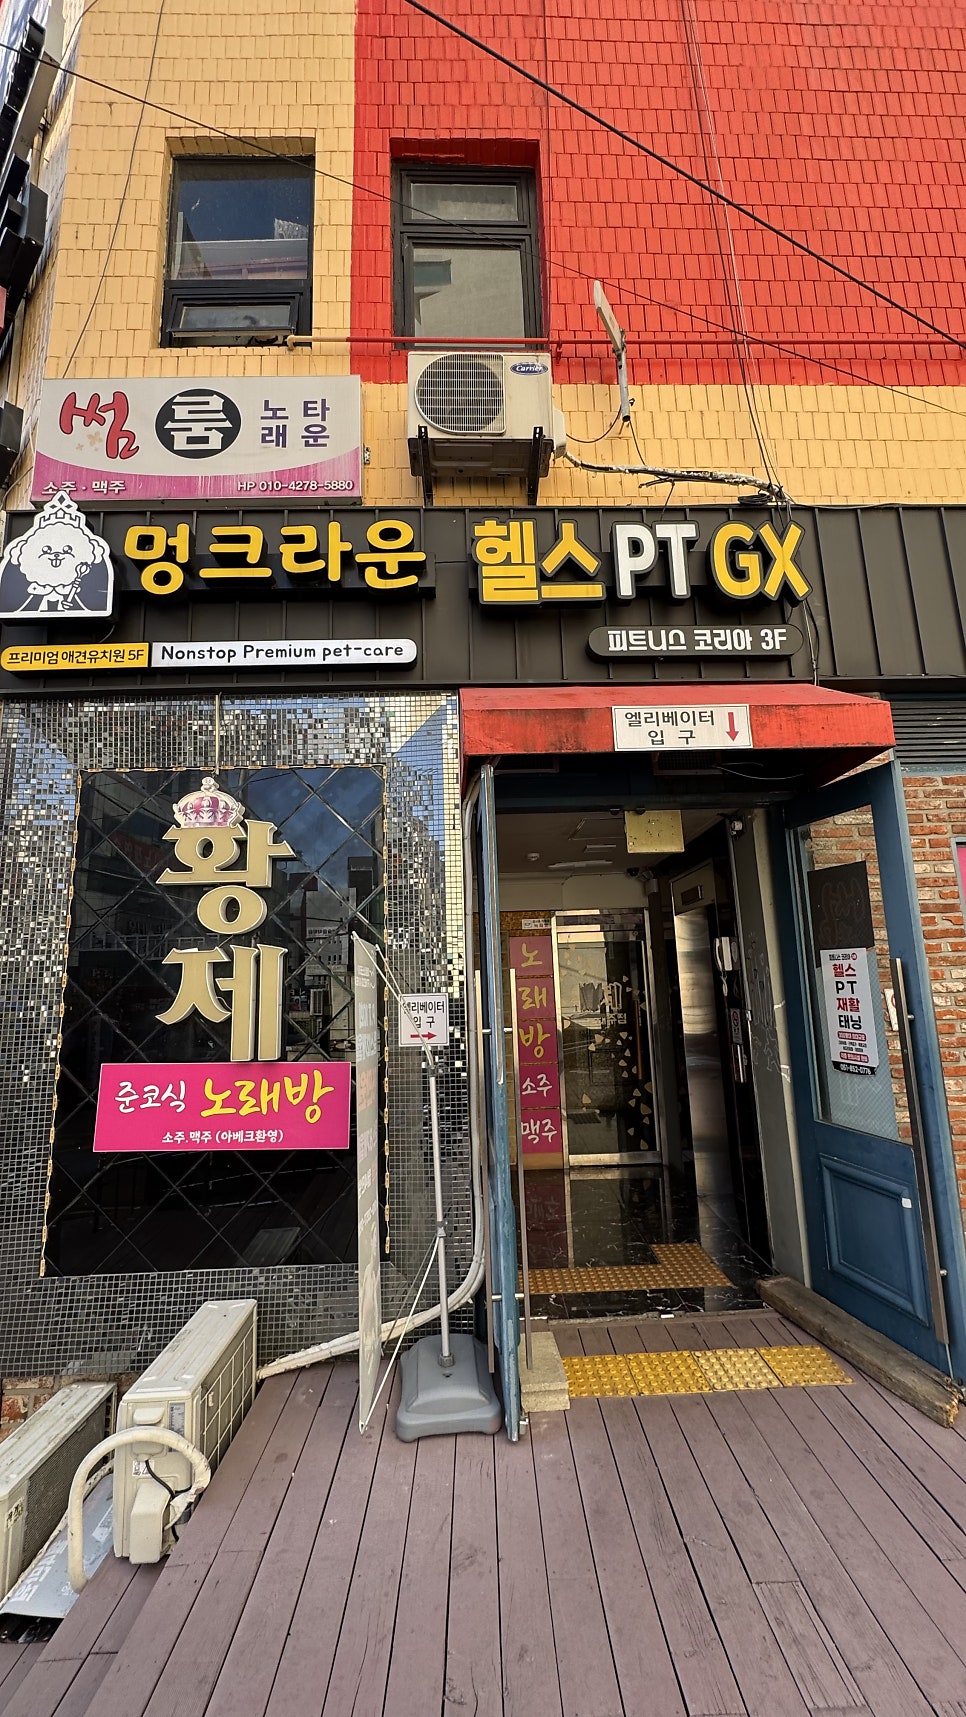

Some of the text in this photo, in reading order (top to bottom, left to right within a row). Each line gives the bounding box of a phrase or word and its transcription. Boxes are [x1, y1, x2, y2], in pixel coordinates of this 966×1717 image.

[41, 480, 126, 495] 소주 맥주
[237, 480, 353, 492] HP 010-4278-5880
[124, 519, 427, 595] 멍크라운
[473, 518, 812, 602] 헬스 PT GX
[608, 628, 787, 651] 피트니스 코리아 3F
[7, 648, 144, 665] 프리미엄 애견유치원 5F
[161, 643, 404, 663] Nonstop Premium pet-care
[624, 710, 715, 728] 엘리베이터
[155, 819, 297, 1063] 황제
[832, 963, 857, 977] 헬스
[835, 980, 857, 995] PT
[403, 1001, 445, 1014] 리베이터
[836, 997, 860, 1012] 재활
[838, 1014, 862, 1030] 태닝
[522, 1073, 553, 1097] 소주
[114, 1081, 186, 1114] 준코식
[200, 1069, 335, 1124] 노래방
[161, 1129, 283, 1144] 소주.맥주 (아베크환영)
[521, 1118, 558, 1144] 맥주
